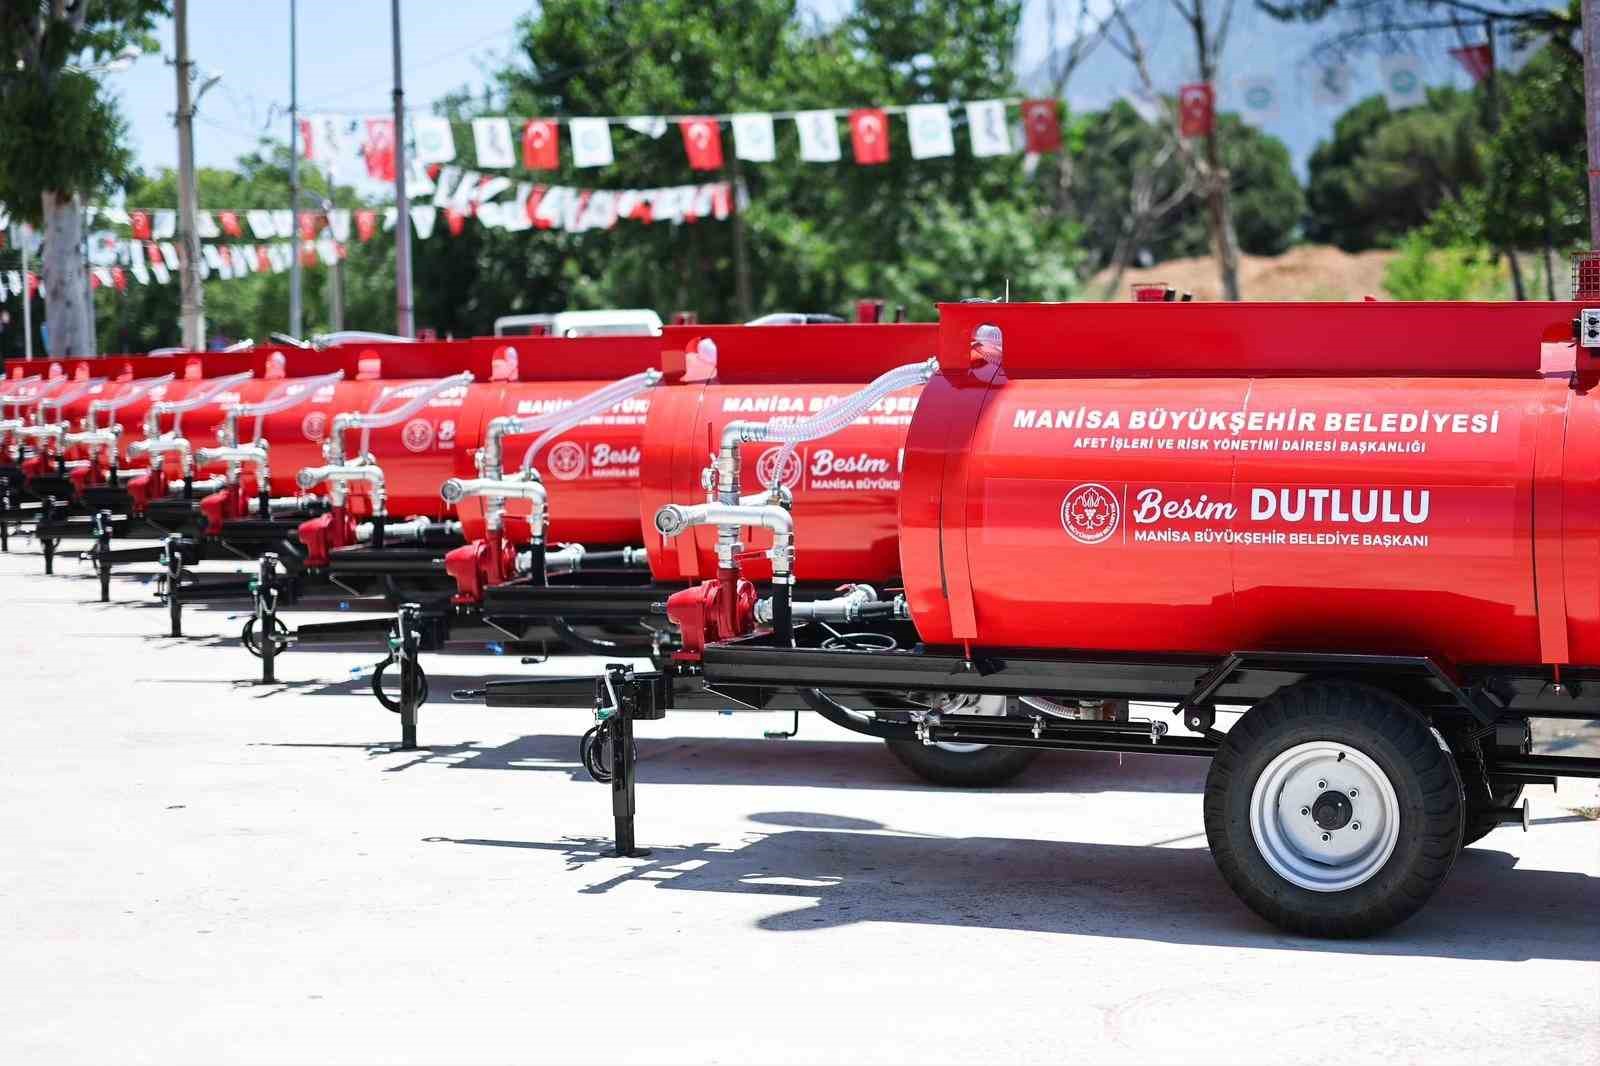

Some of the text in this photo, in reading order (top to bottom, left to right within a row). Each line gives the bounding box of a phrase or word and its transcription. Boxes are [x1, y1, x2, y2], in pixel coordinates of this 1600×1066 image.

[1013, 407, 1500, 435] MANİSA BÜYÜKŞEHİR BELEDİYESİ
[1073, 436, 1426, 454] AFET İŞLERİ VE RİSK YÖNETİMİ DAİRESİ BAŞKANLIĞI
[811, 448, 890, 476] Besim
[856, 478, 901, 491] BÜYÜKŞ
[1132, 488, 1238, 524] Besim
[1251, 488, 1430, 524] DUTLULU
[1134, 528, 1429, 548] MANİSA BÜYÜKŞEHİR BELEDİYE BAŞKANI
